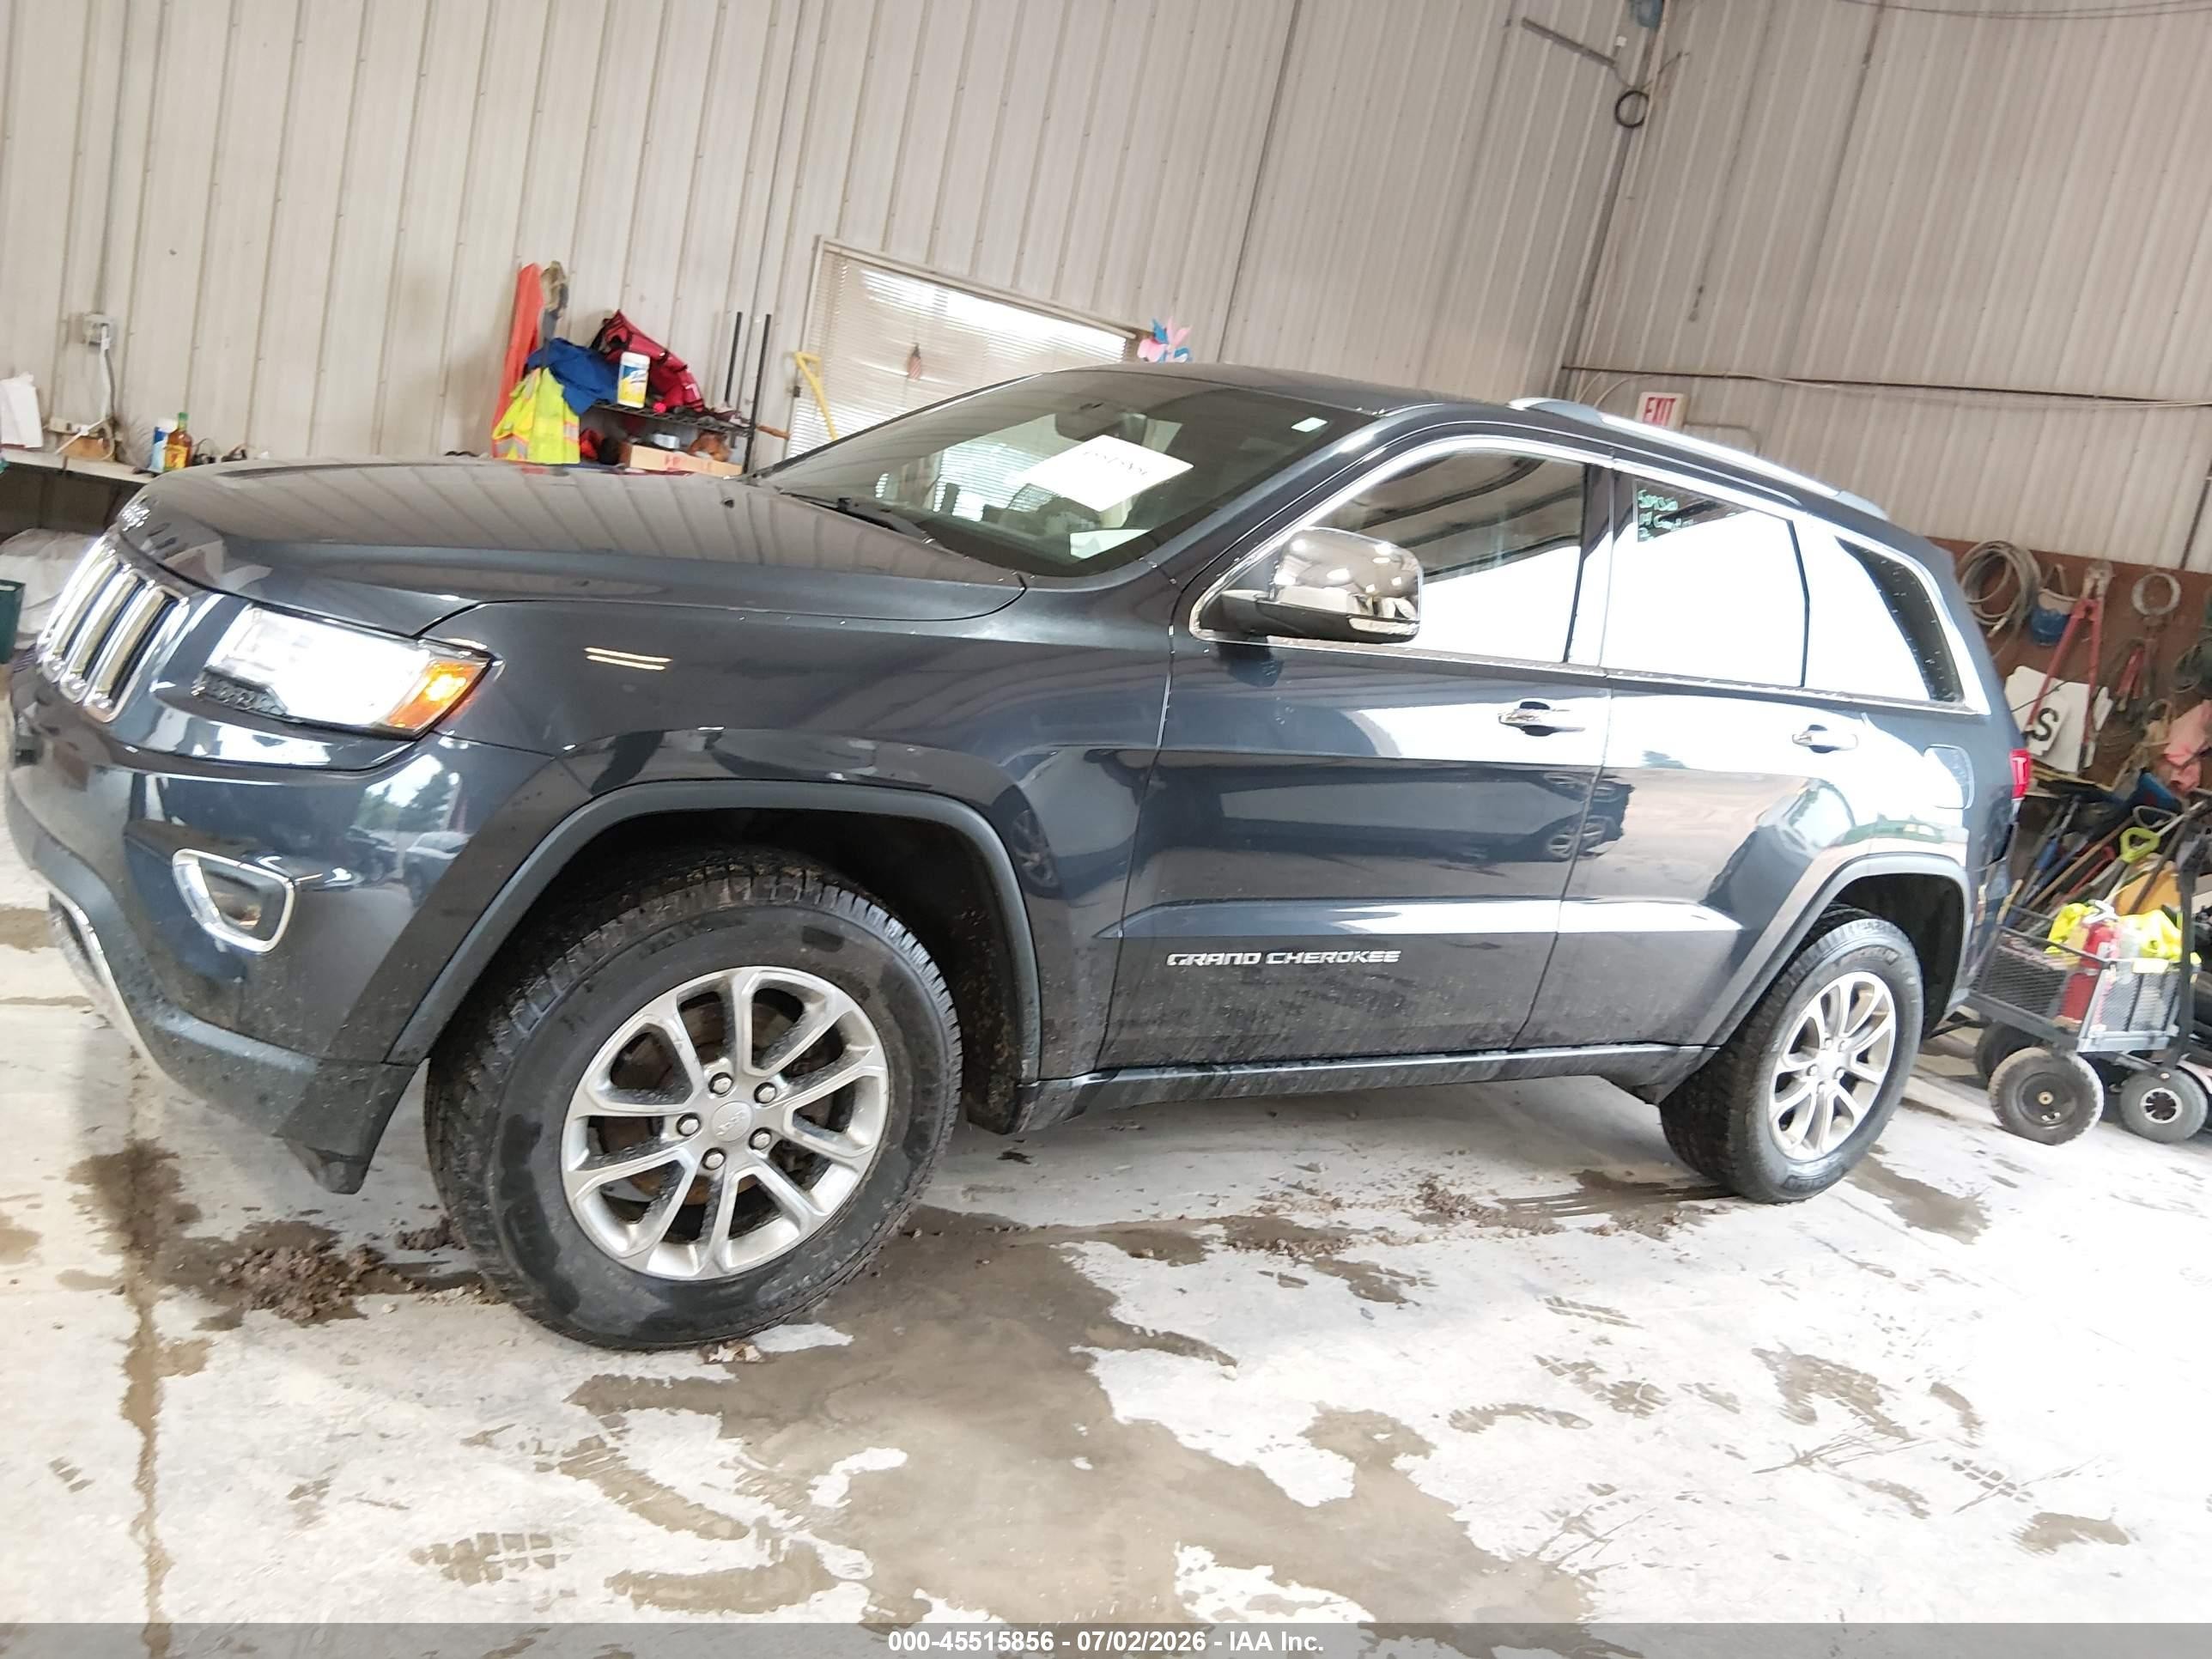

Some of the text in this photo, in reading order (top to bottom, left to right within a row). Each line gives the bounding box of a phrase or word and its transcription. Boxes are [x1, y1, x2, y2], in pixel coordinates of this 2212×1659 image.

[1642, 397, 1676, 426] EXIT
[2031, 707, 2059, 741] S
[1166, 950, 1401, 966] GRAND CHEROKEE
